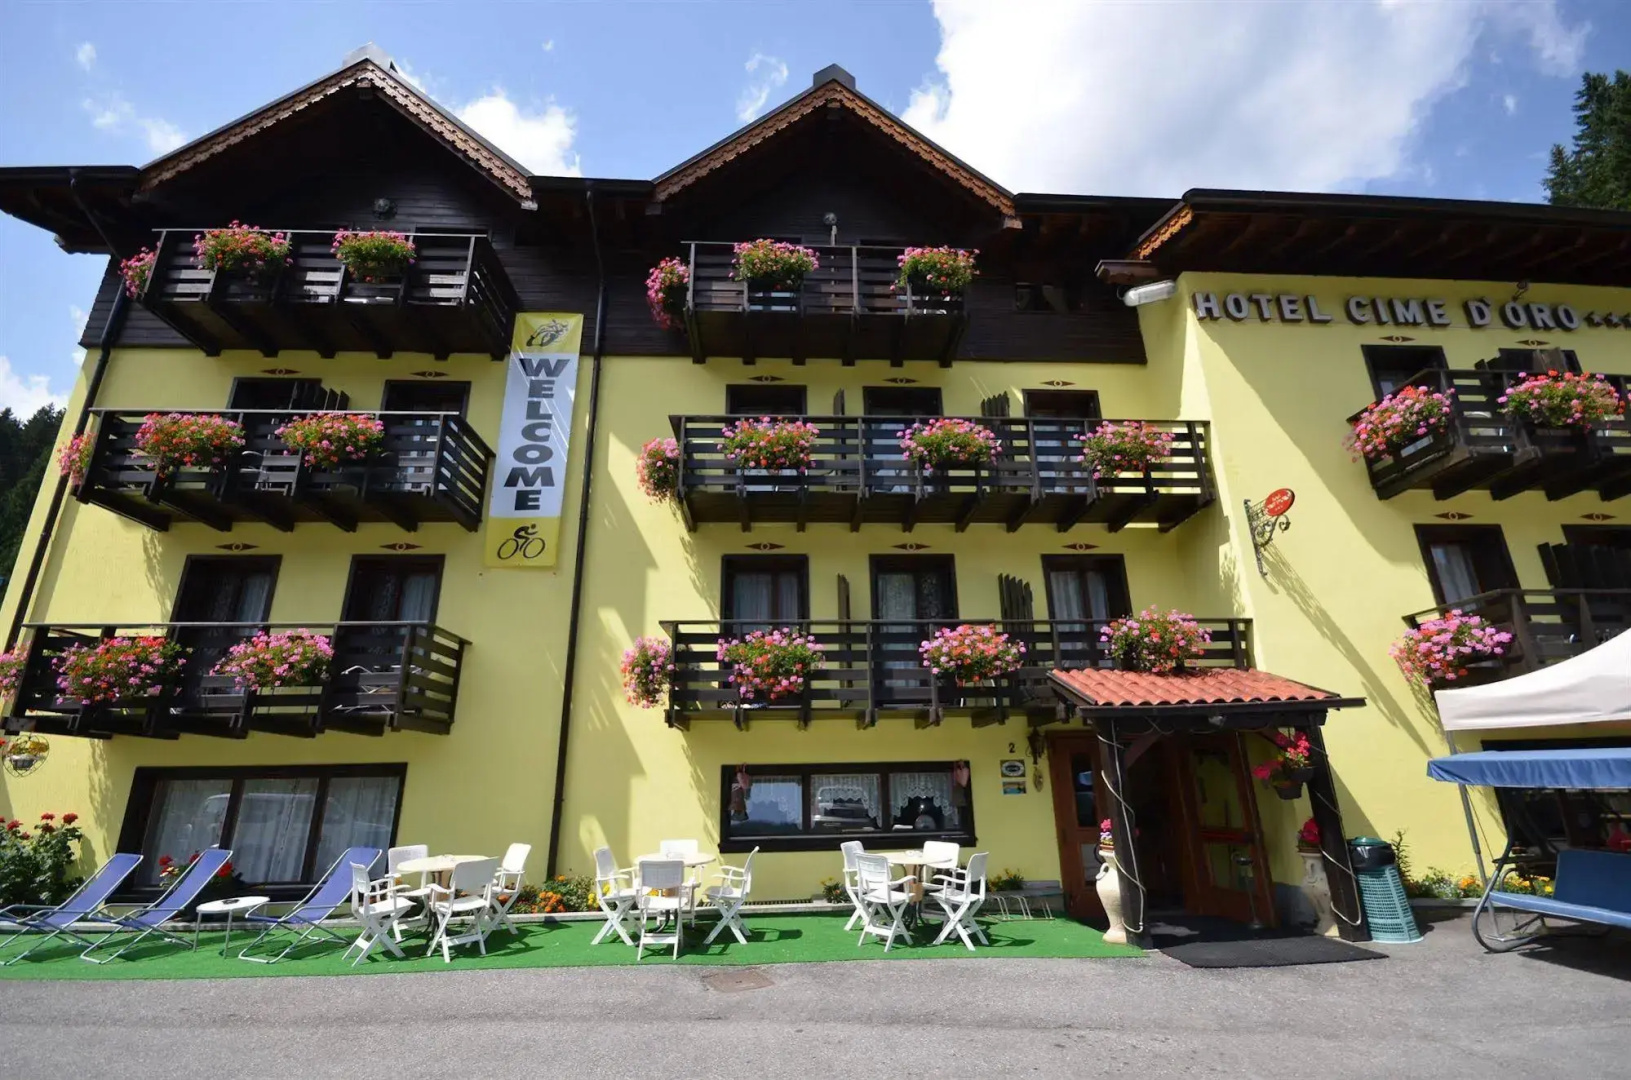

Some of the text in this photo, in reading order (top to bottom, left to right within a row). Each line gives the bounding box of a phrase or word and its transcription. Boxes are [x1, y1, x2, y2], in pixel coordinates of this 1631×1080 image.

[1192, 292, 1580, 332] HOTEL CIME D'ORO
[503, 357, 571, 511] WELCOME
[1008, 742, 1016, 754] 2
